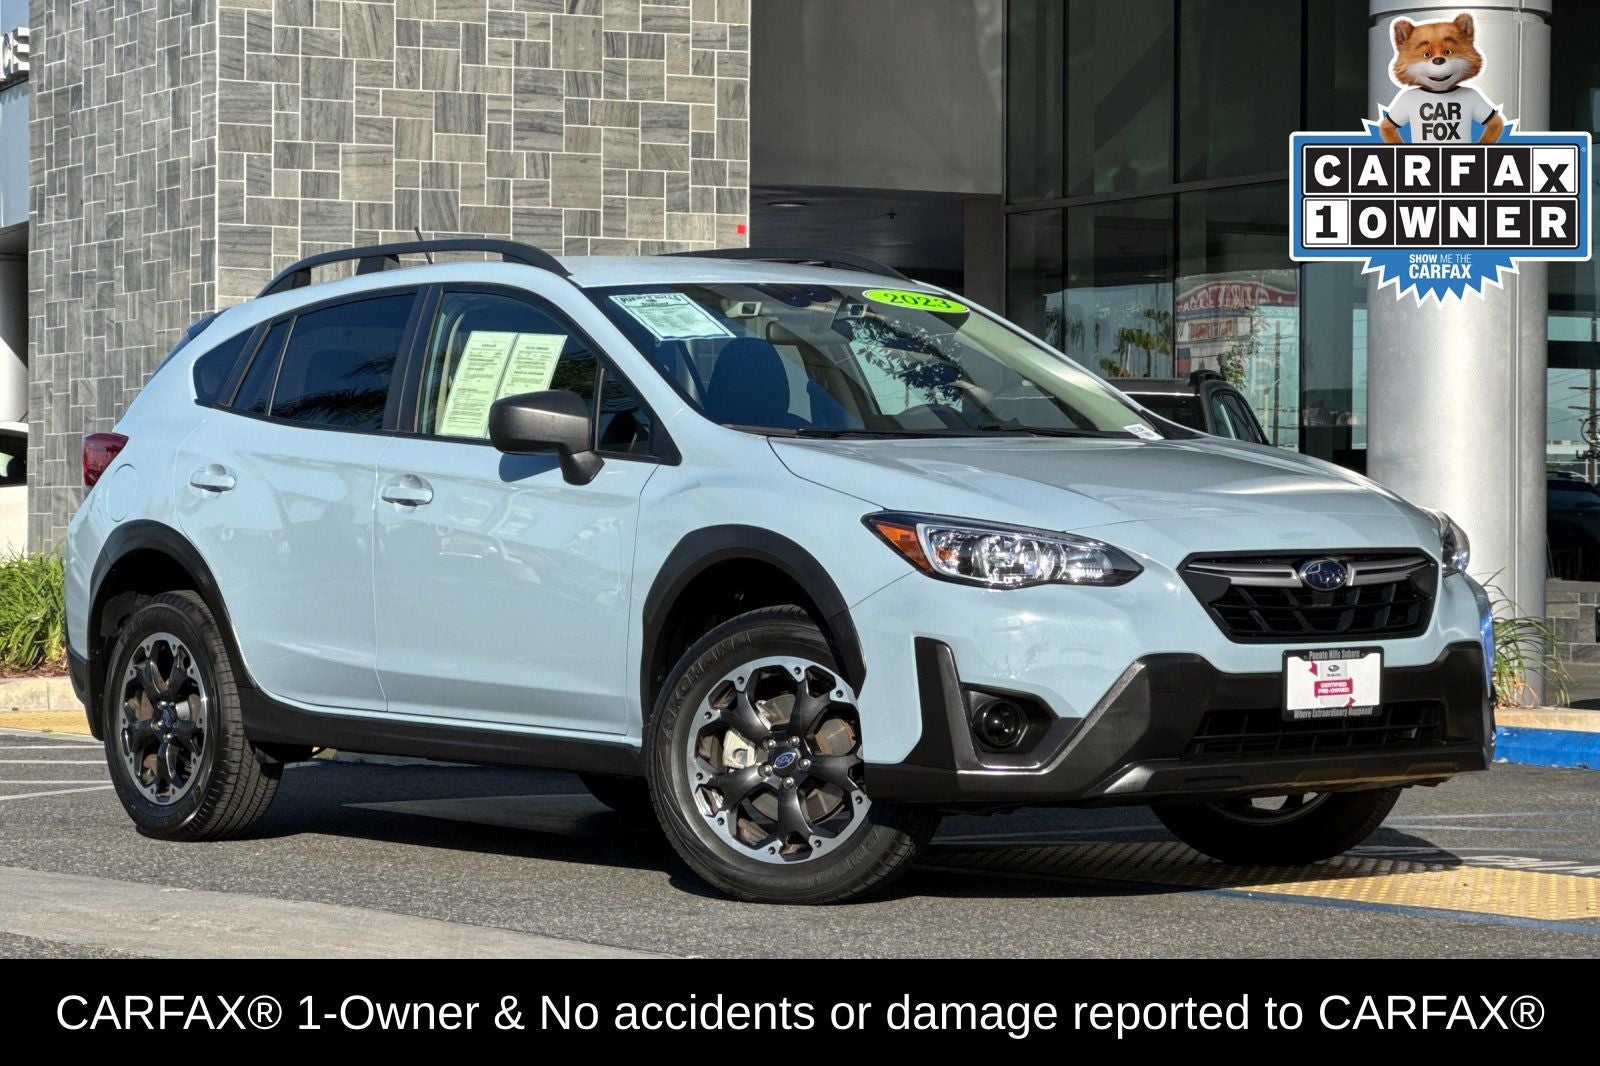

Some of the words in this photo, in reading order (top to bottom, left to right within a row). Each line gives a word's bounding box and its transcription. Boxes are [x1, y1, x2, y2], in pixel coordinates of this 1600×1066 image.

[884, 293, 951, 309] 2023
[1309, 650, 1328, 660] Puente
[1329, 650, 1341, 659] Hills
[1341, 649, 1361, 659] Subaru
[1320, 681, 1348, 689] CERTIFIED
[1294, 710, 1312, 719] Where
[1312, 709, 1348, 718] Extraordinary
